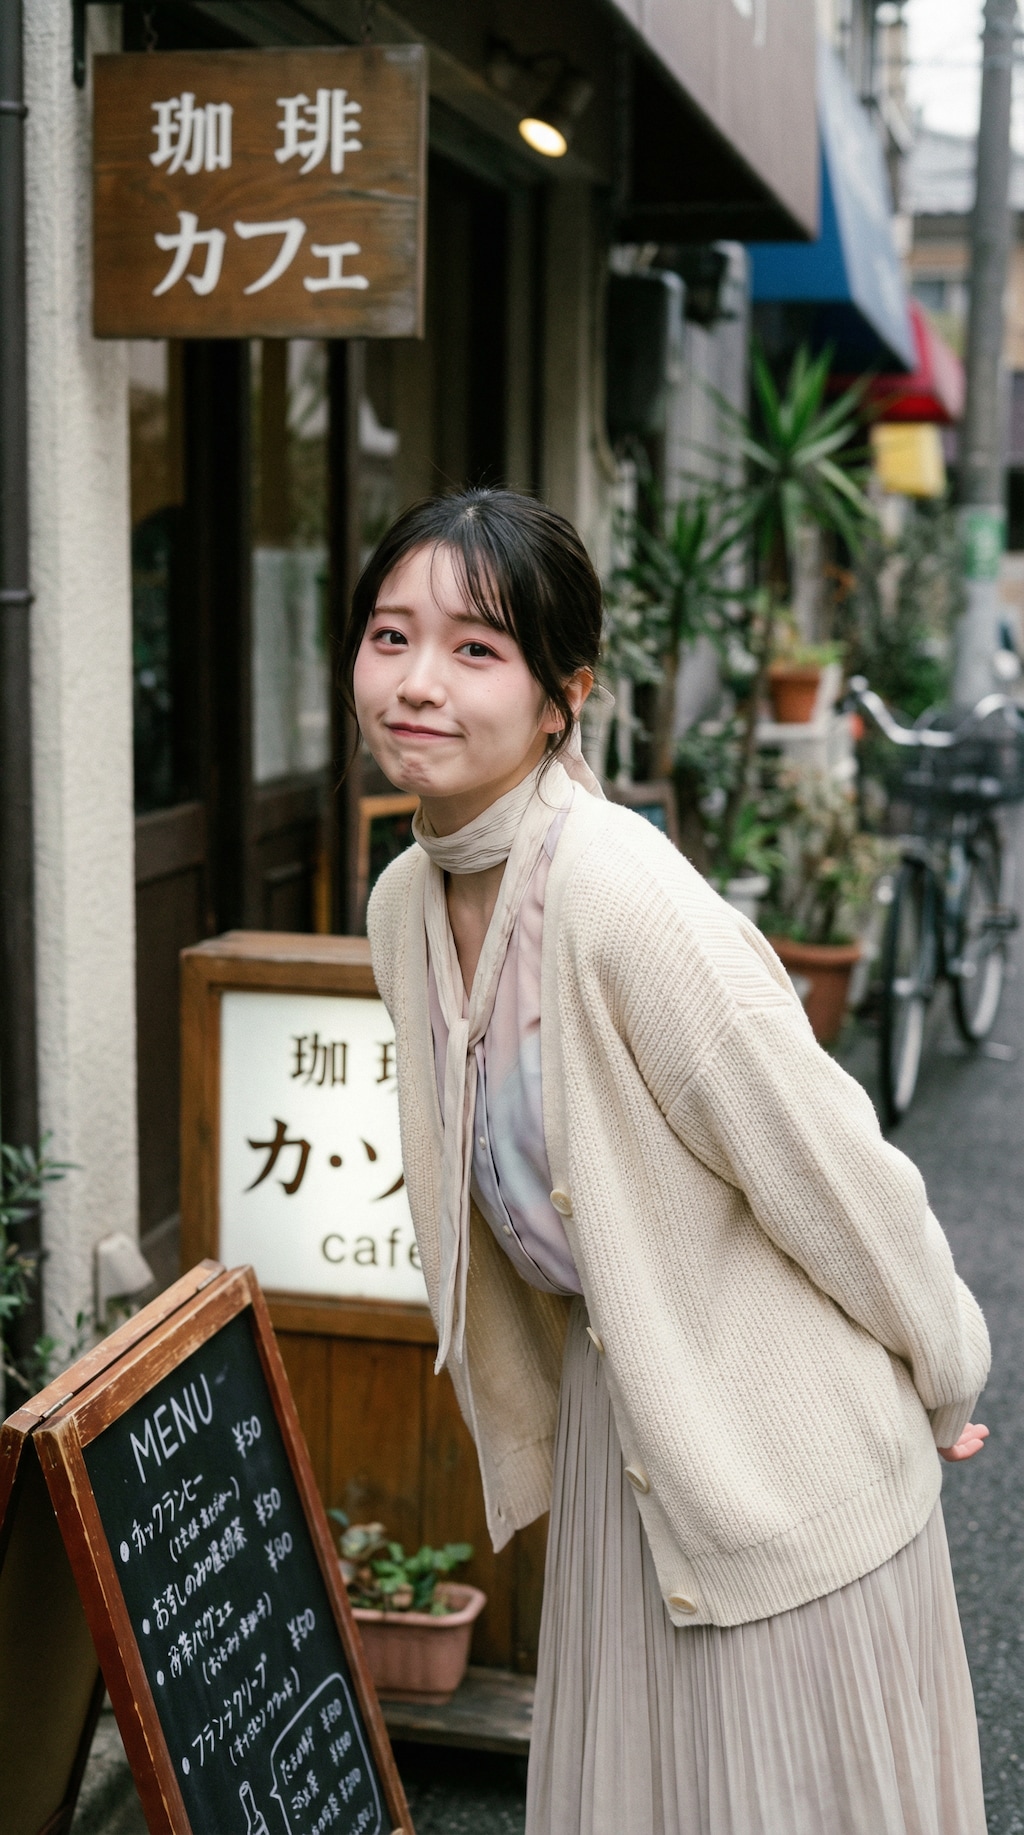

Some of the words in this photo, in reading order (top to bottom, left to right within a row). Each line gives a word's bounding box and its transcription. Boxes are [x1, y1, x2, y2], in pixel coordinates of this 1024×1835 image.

[152, 211, 369, 296] カフェ
[130, 1373, 213, 1484] MENU
[232, 1415, 262, 1458] ¥50
[253, 1487, 281, 1527] ¥50
